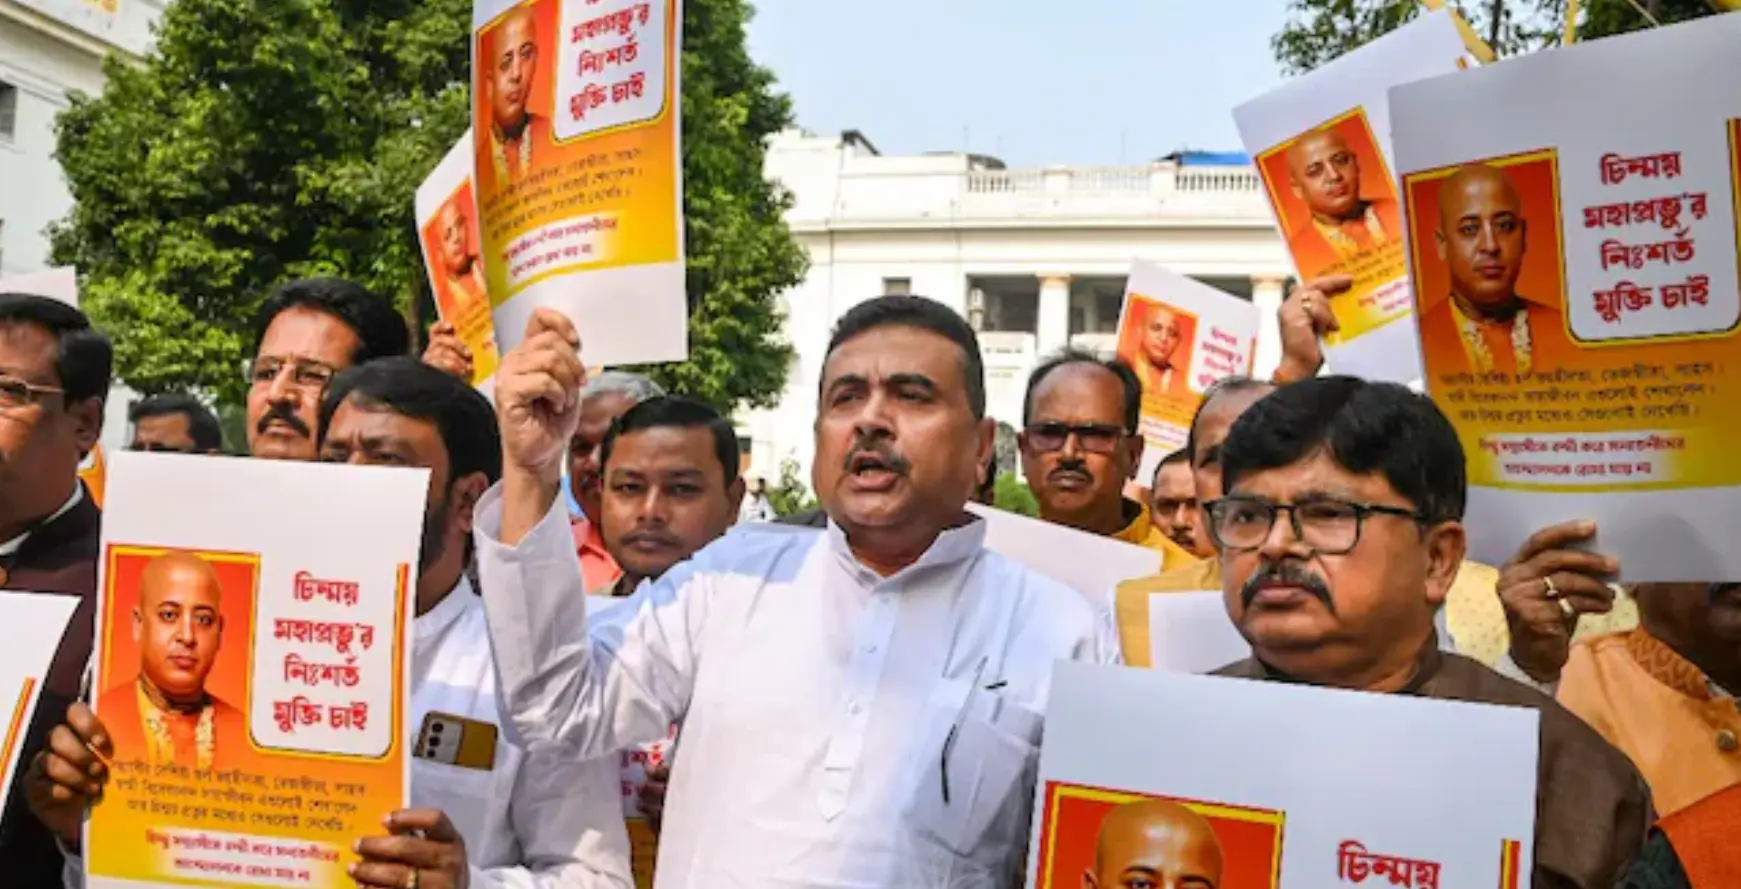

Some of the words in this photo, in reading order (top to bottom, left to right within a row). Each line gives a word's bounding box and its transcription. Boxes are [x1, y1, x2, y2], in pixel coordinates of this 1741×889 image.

[611, 71, 646, 103] চাই
[1599, 152, 1682, 185] চিন্ময়
[1600, 226, 1694, 271] নিঃশর্ত
[1592, 280, 1653, 323] মুক্তি
[1659, 274, 1709, 309] চাই
[294, 571, 359, 606] চিন্ময়
[284, 653, 360, 687] নিঃশর্ত
[273, 696, 322, 733] মুক্তি
[329, 701, 369, 730] চাই
[1337, 839, 1441, 889] চিন্ময়
